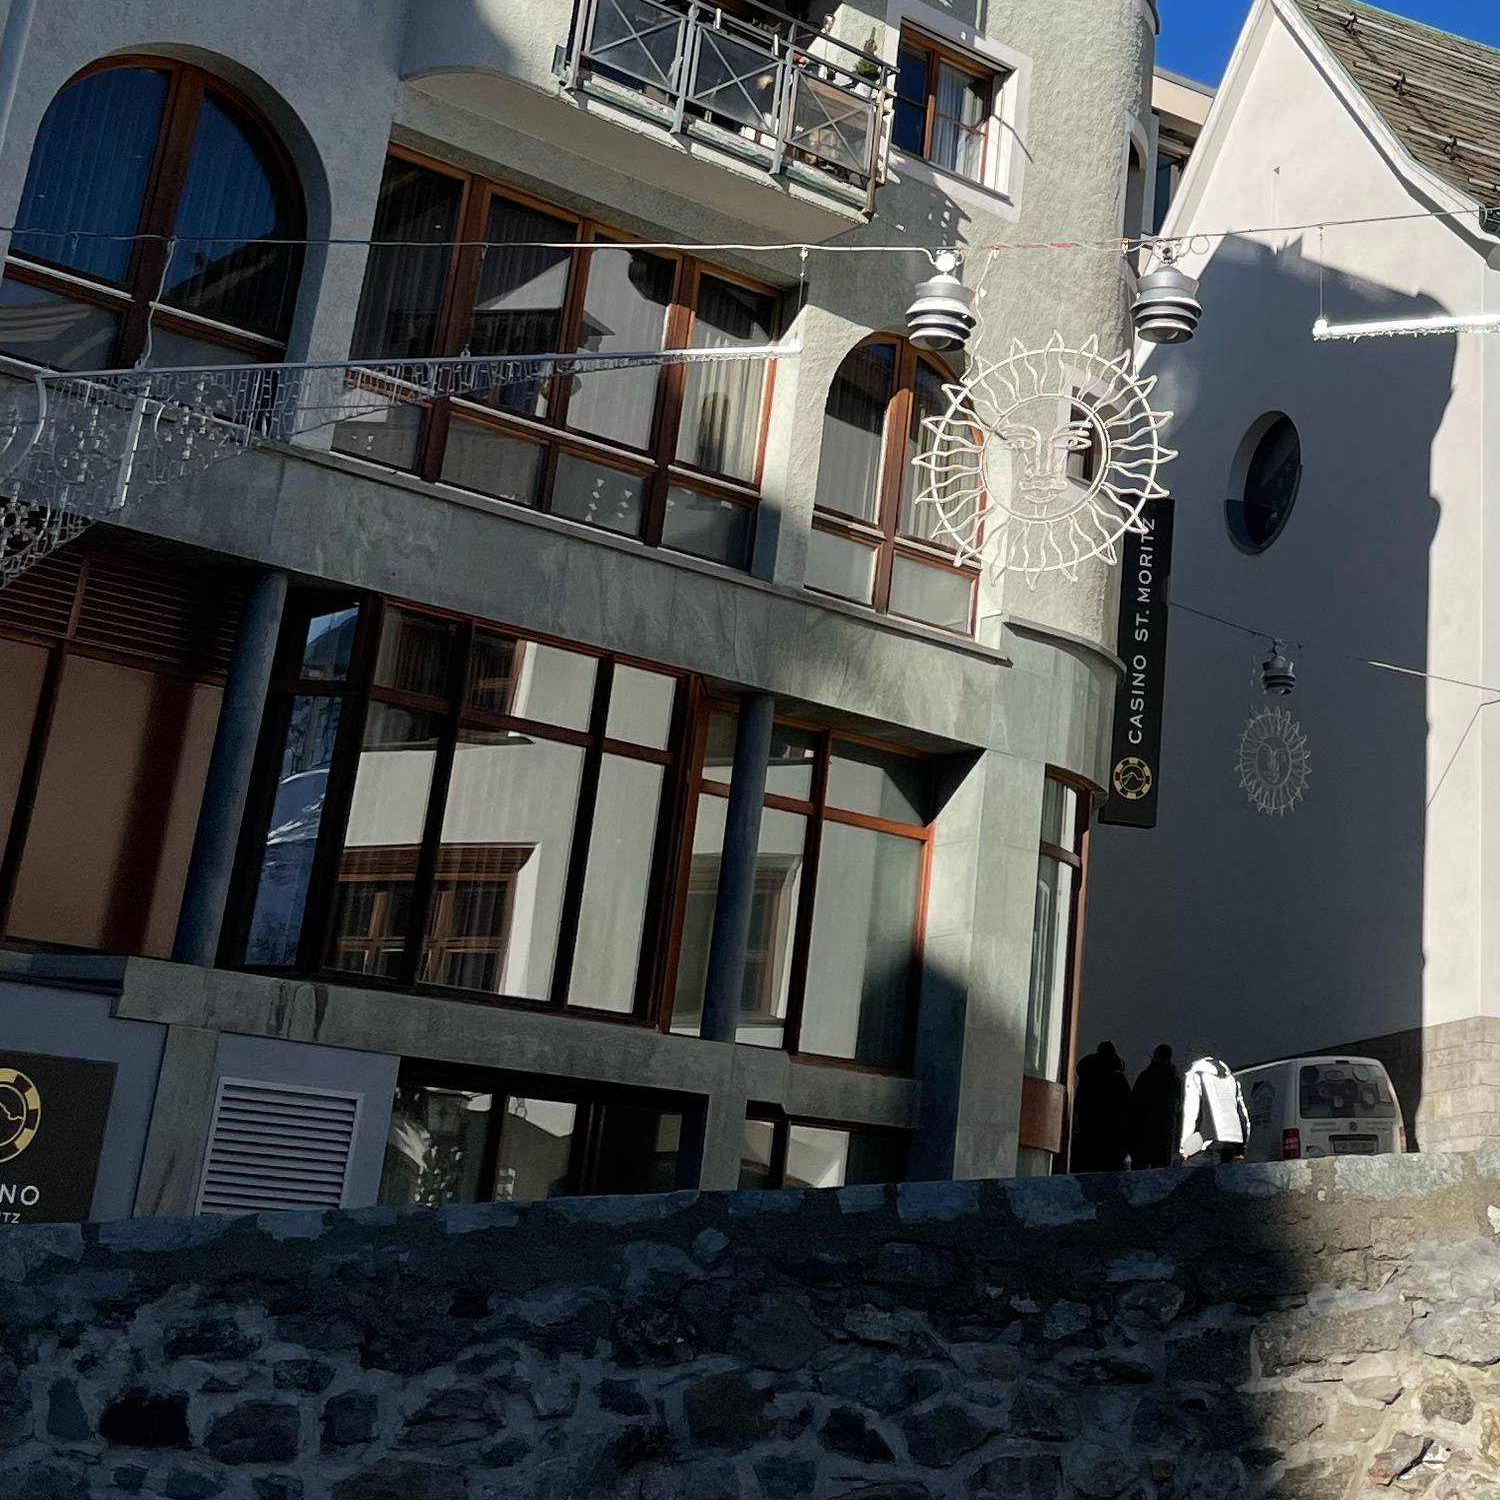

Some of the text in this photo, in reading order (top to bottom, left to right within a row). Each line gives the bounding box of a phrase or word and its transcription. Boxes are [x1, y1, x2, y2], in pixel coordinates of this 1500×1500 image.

[1128, 517, 1156, 745] CASINO ST. MORITZ
